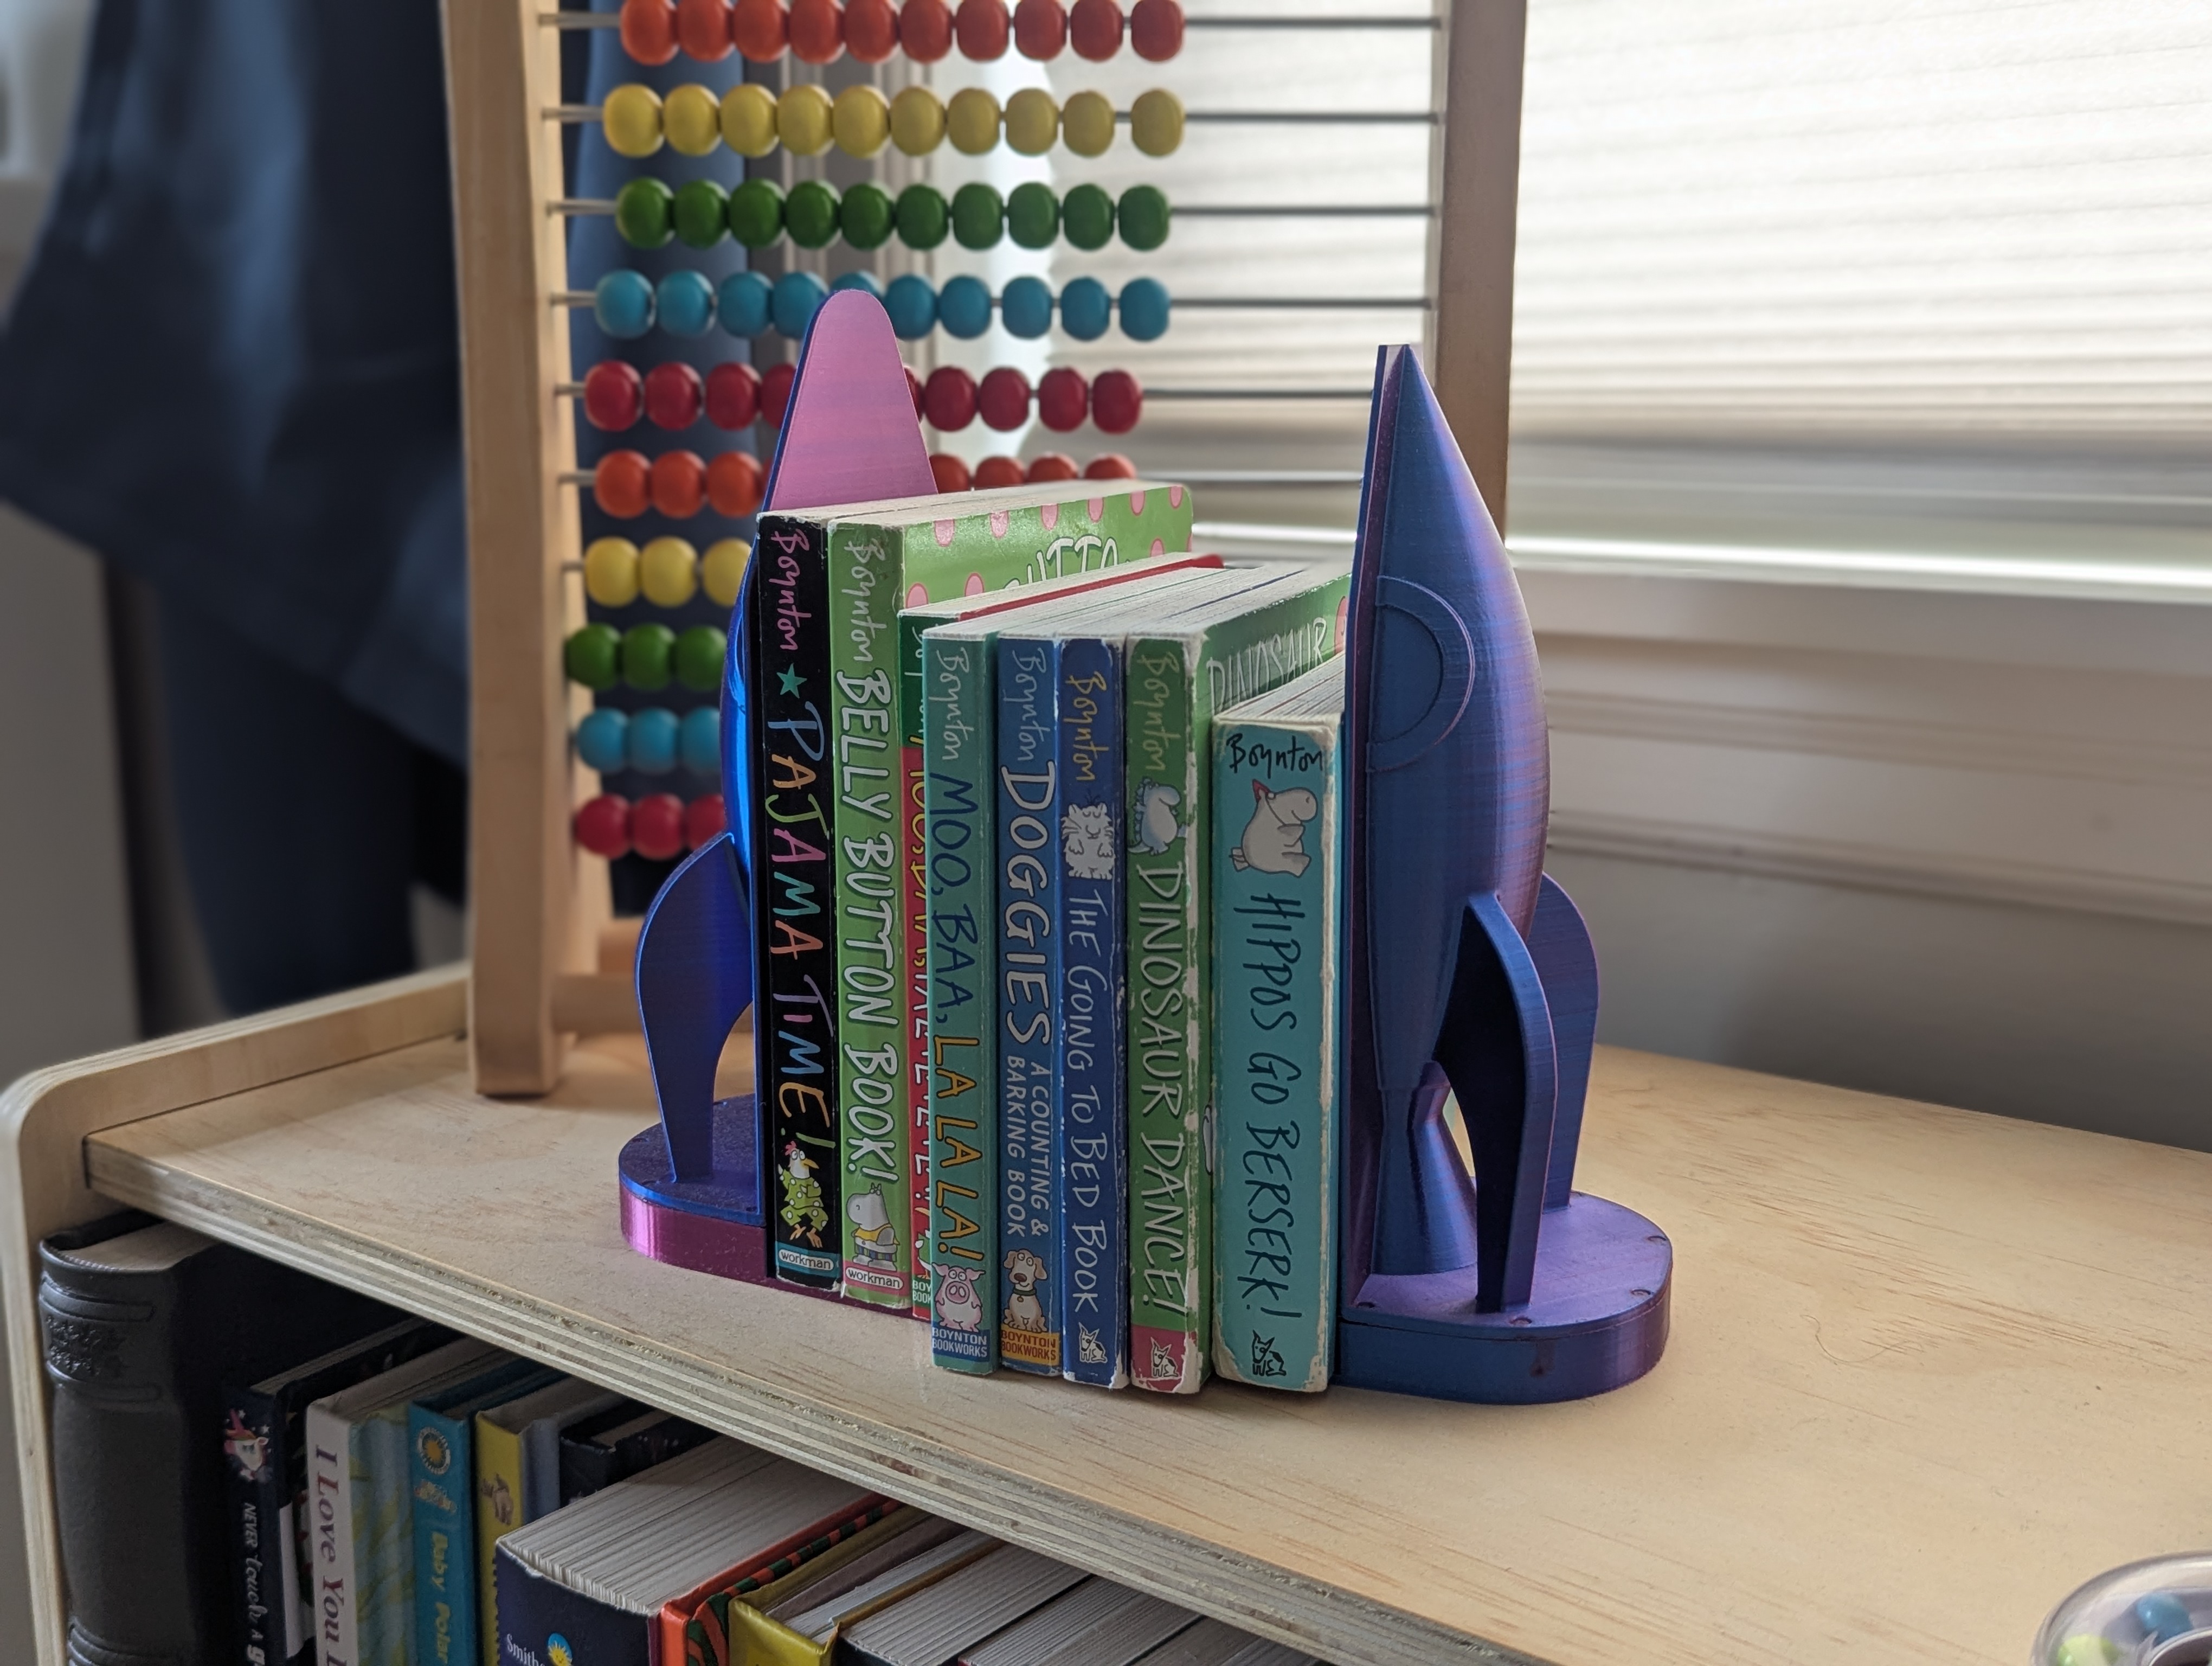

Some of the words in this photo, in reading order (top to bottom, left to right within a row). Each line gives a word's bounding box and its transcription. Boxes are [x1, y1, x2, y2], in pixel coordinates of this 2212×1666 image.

[768, 528, 812, 651] Boynton
[842, 537, 888, 662] Boynton
[929, 646, 974, 760] Boynton
[1002, 647, 1051, 761] Boynton
[1134, 650, 1181, 771] Boynton
[1206, 617, 1327, 717] DINOSAUR
[835, 669, 892, 819] BELLY
[1063, 671, 1109, 781] Boynton
[1225, 733, 1323, 779] Boynton
[765, 701, 828, 960] PAJAMA
[929, 772, 979, 896] MOO,
[841, 832, 898, 1026] BUTTON
[1001, 760, 1056, 1046] DOGGIES
[1068, 888, 1108, 958] THE
[931, 904, 978, 1024] BAA,
[1136, 861, 1183, 1119] DINOSAUR
[1233, 893, 1306, 1030] HIPPOS
[773, 974, 835, 1149] TIME!
[1065, 965, 1107, 1072] GOING
[843, 1042, 899, 1182] BOOK!
[933, 1035, 979, 1099] LA
[1006, 1055, 1026, 1160] BARKING
[1030, 1060, 1051, 1077] A
[1248, 1052, 1302, 1105] GO
[935, 1116, 982, 1168] LA
[1031, 1085, 1050, 1215] COUNTING
[1070, 1132, 1107, 1208] BED
[936, 1180, 984, 1261] LA!
[1006, 1170, 1026, 1238] BOOK
[1031, 1220, 1049, 1236] &
[1140, 1131, 1188, 1316] DANCE!
[1237, 1120, 1302, 1319] BERSERK!
[781, 1248, 832, 1271] workman
[847, 1267, 901, 1289] workman
[1071, 1220, 1107, 1313] BOOK
[932, 1327, 987, 1345] BOYNTON
[932, 1337, 988, 1358] BOOKWORKS
[1002, 1329, 1056, 1348] BOYNTON
[1002, 1341, 1057, 1361] BOOKWORKS
[316, 1444, 338, 1465] I
[244, 1502, 259, 1548] NEVER
[317, 1471, 339, 1563] Love
[246, 1554, 268, 1624] touch
[323, 1575, 345, 1643] You
